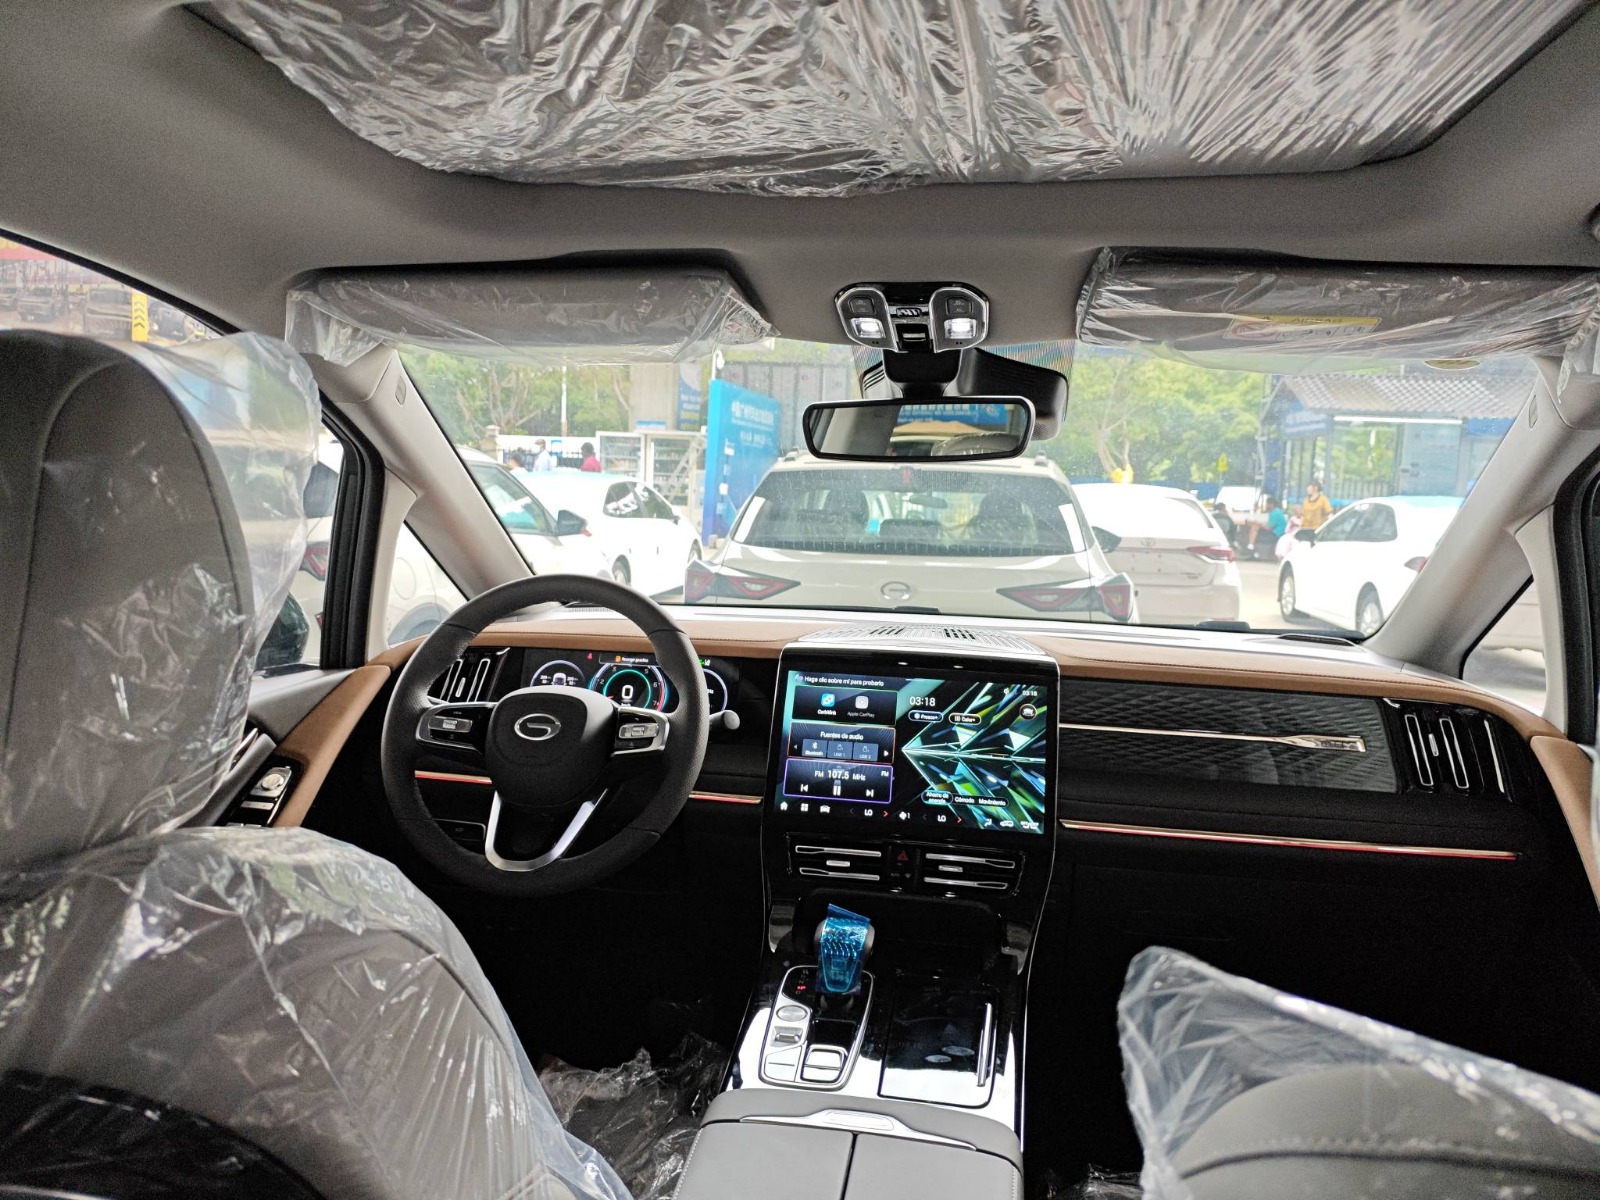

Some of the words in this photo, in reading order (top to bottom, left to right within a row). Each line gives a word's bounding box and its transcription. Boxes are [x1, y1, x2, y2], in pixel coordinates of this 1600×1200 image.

[622, 685, 634, 699] 0
[909, 696, 936, 706] 03:18
[820, 731, 841, 739] Fuentes
[827, 770, 850, 780] 107.5
[852, 773, 866, 781] MHz
[864, 808, 873, 816] LO
[937, 814, 947, 822] LO
